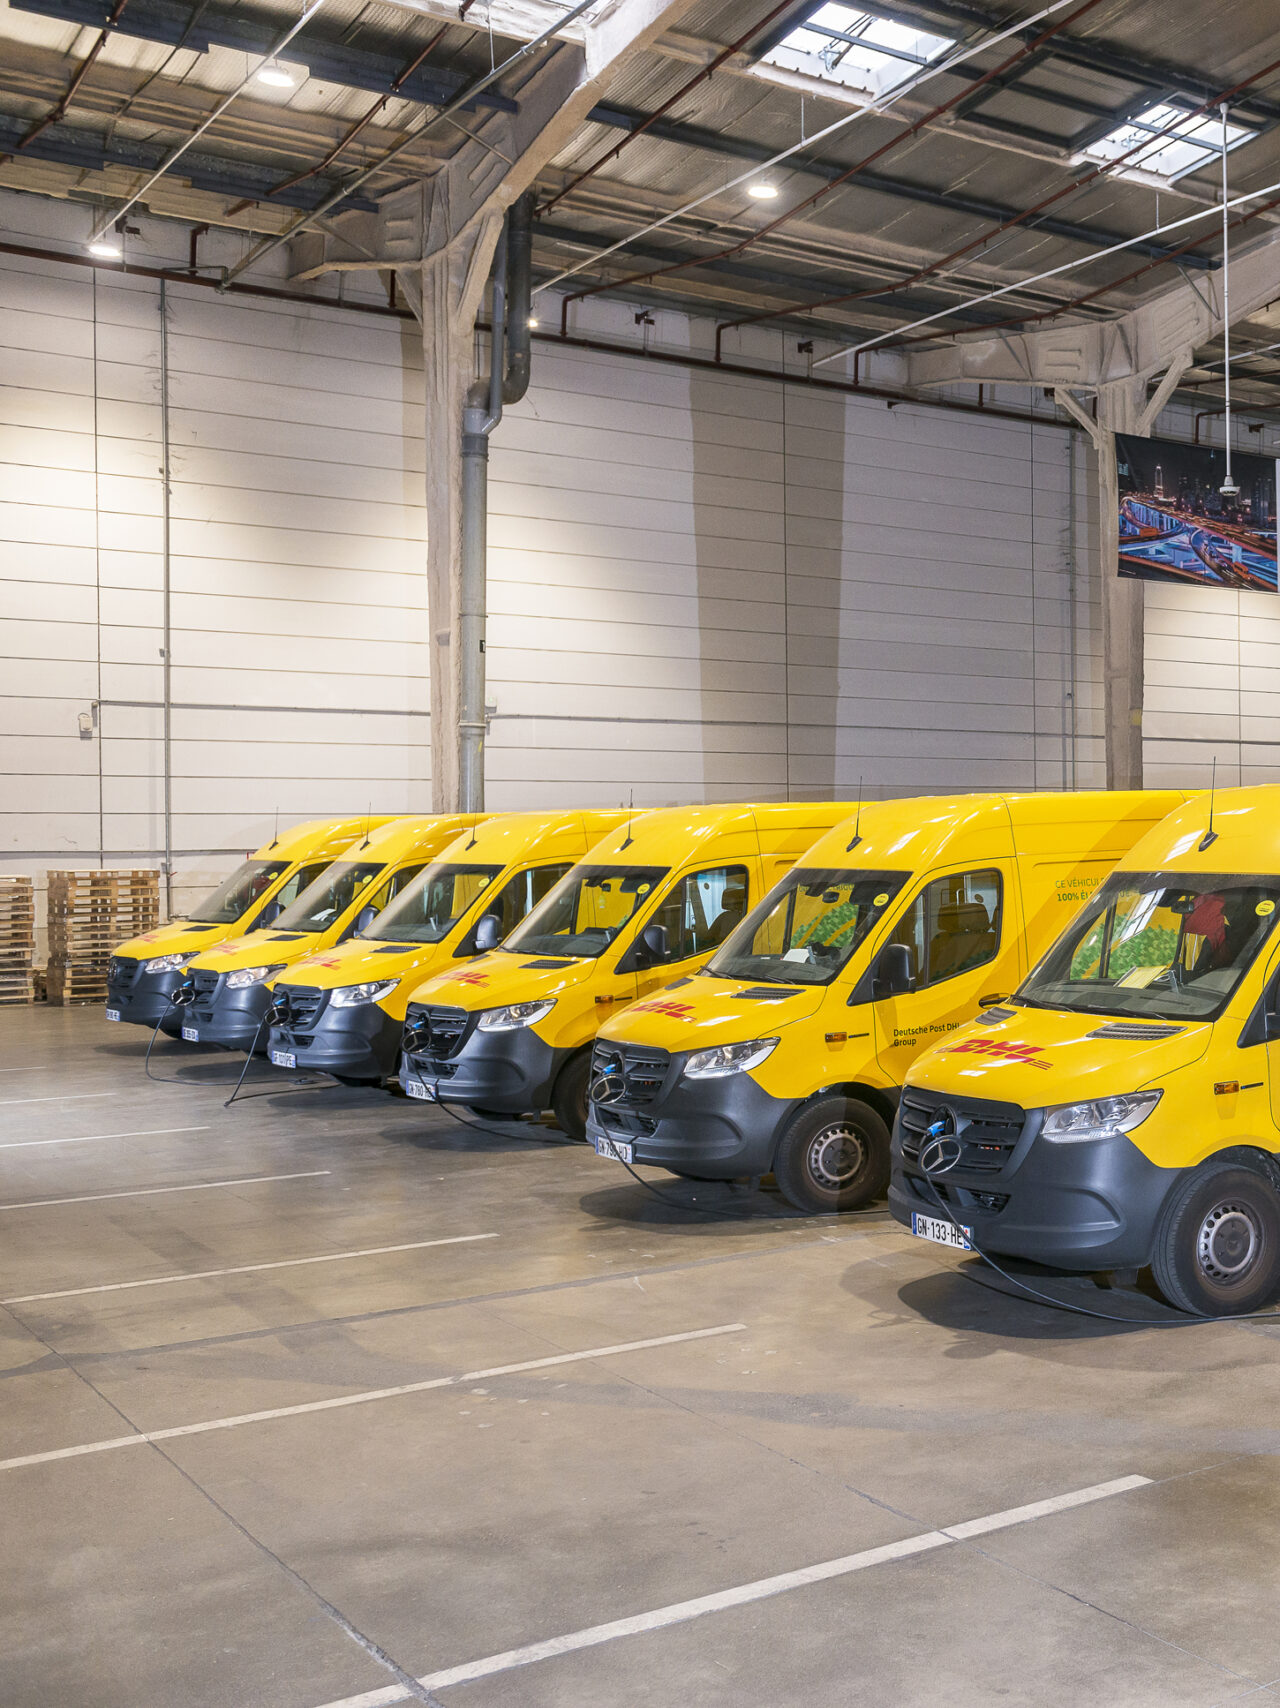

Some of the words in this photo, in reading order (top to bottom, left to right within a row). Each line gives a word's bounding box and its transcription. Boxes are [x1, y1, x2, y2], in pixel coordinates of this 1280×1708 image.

[1056, 880, 1066, 889] CE
[1057, 892, 1079, 902] 100%
[631, 1001, 697, 1018] DHL
[893, 1026, 928, 1037] Deutsche
[929, 1024, 945, 1033] Post
[893, 1038, 917, 1047] Group
[948, 1039, 1046, 1064] DHL
[917, 1217, 963, 1246] GN-133-HE
